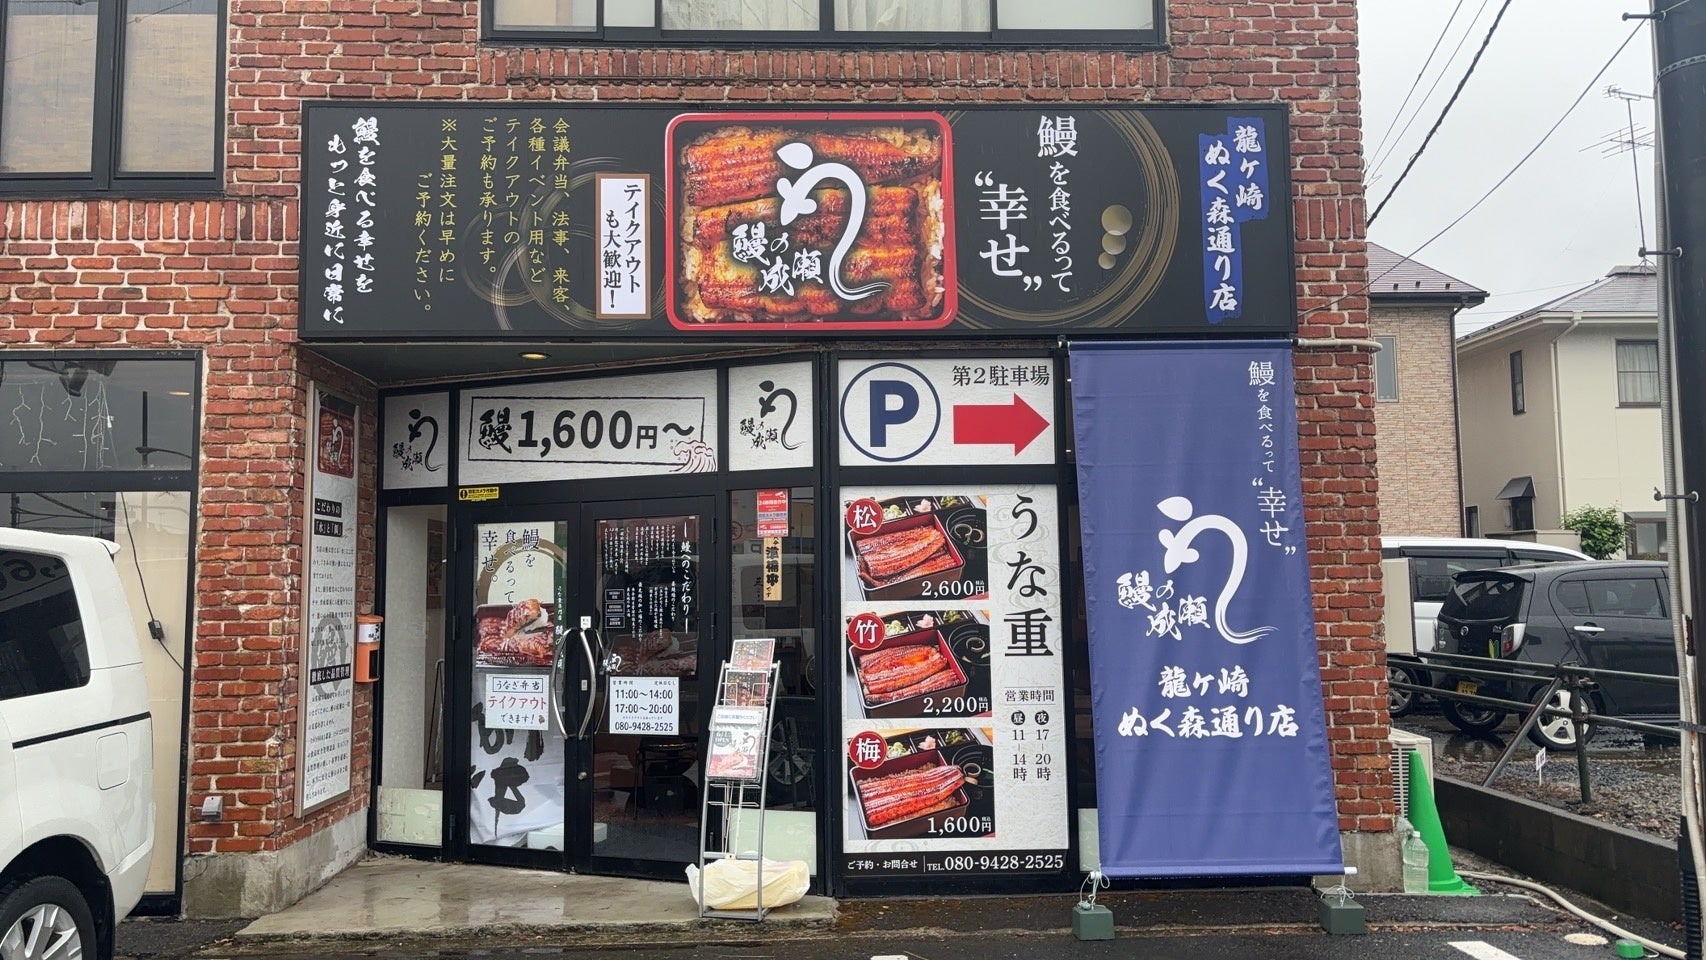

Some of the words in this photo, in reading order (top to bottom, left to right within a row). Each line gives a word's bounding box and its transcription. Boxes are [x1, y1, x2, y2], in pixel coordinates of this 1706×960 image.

[323, 134, 348, 324] もっと身近に日常に
[352, 116, 380, 293] 鰻を食べる幸せを
[439, 118, 458, 282] ※大量注文は早めに
[479, 118, 498, 275] ご予約も承ります。
[503, 118, 521, 245] テイクアウトの
[527, 117, 547, 283] 各種イベント用など
[552, 117, 571, 312] 会議弁当、法事、来客、
[1037, 115, 1079, 293] 鰻を食べるって
[1204, 140, 1238, 311] ぬく森通り店
[413, 172, 433, 311] ご予約ください。
[623, 183, 642, 294] テイクアウト
[952, 365, 1050, 387] 第2駐車場
[1248, 360, 1276, 474] 鰻を食べるって
[481, 530, 498, 583] 幸せ。
[504, 529, 517, 603] 食べるって
[522, 528, 539, 568] 鰻を
[853, 505, 877, 529] 松
[1003, 493, 1055, 656] うな重
[496, 680, 540, 691] うなぎ弁当
[854, 619, 879, 643] 竹
[488, 696, 547, 711] テイクアウト
[614, 721, 674, 732] 080-9428-2525
[855, 738, 881, 763] 梅
[1005, 689, 1055, 702] 営業時間
[1118, 705, 1299, 738] ぬく森通り店
